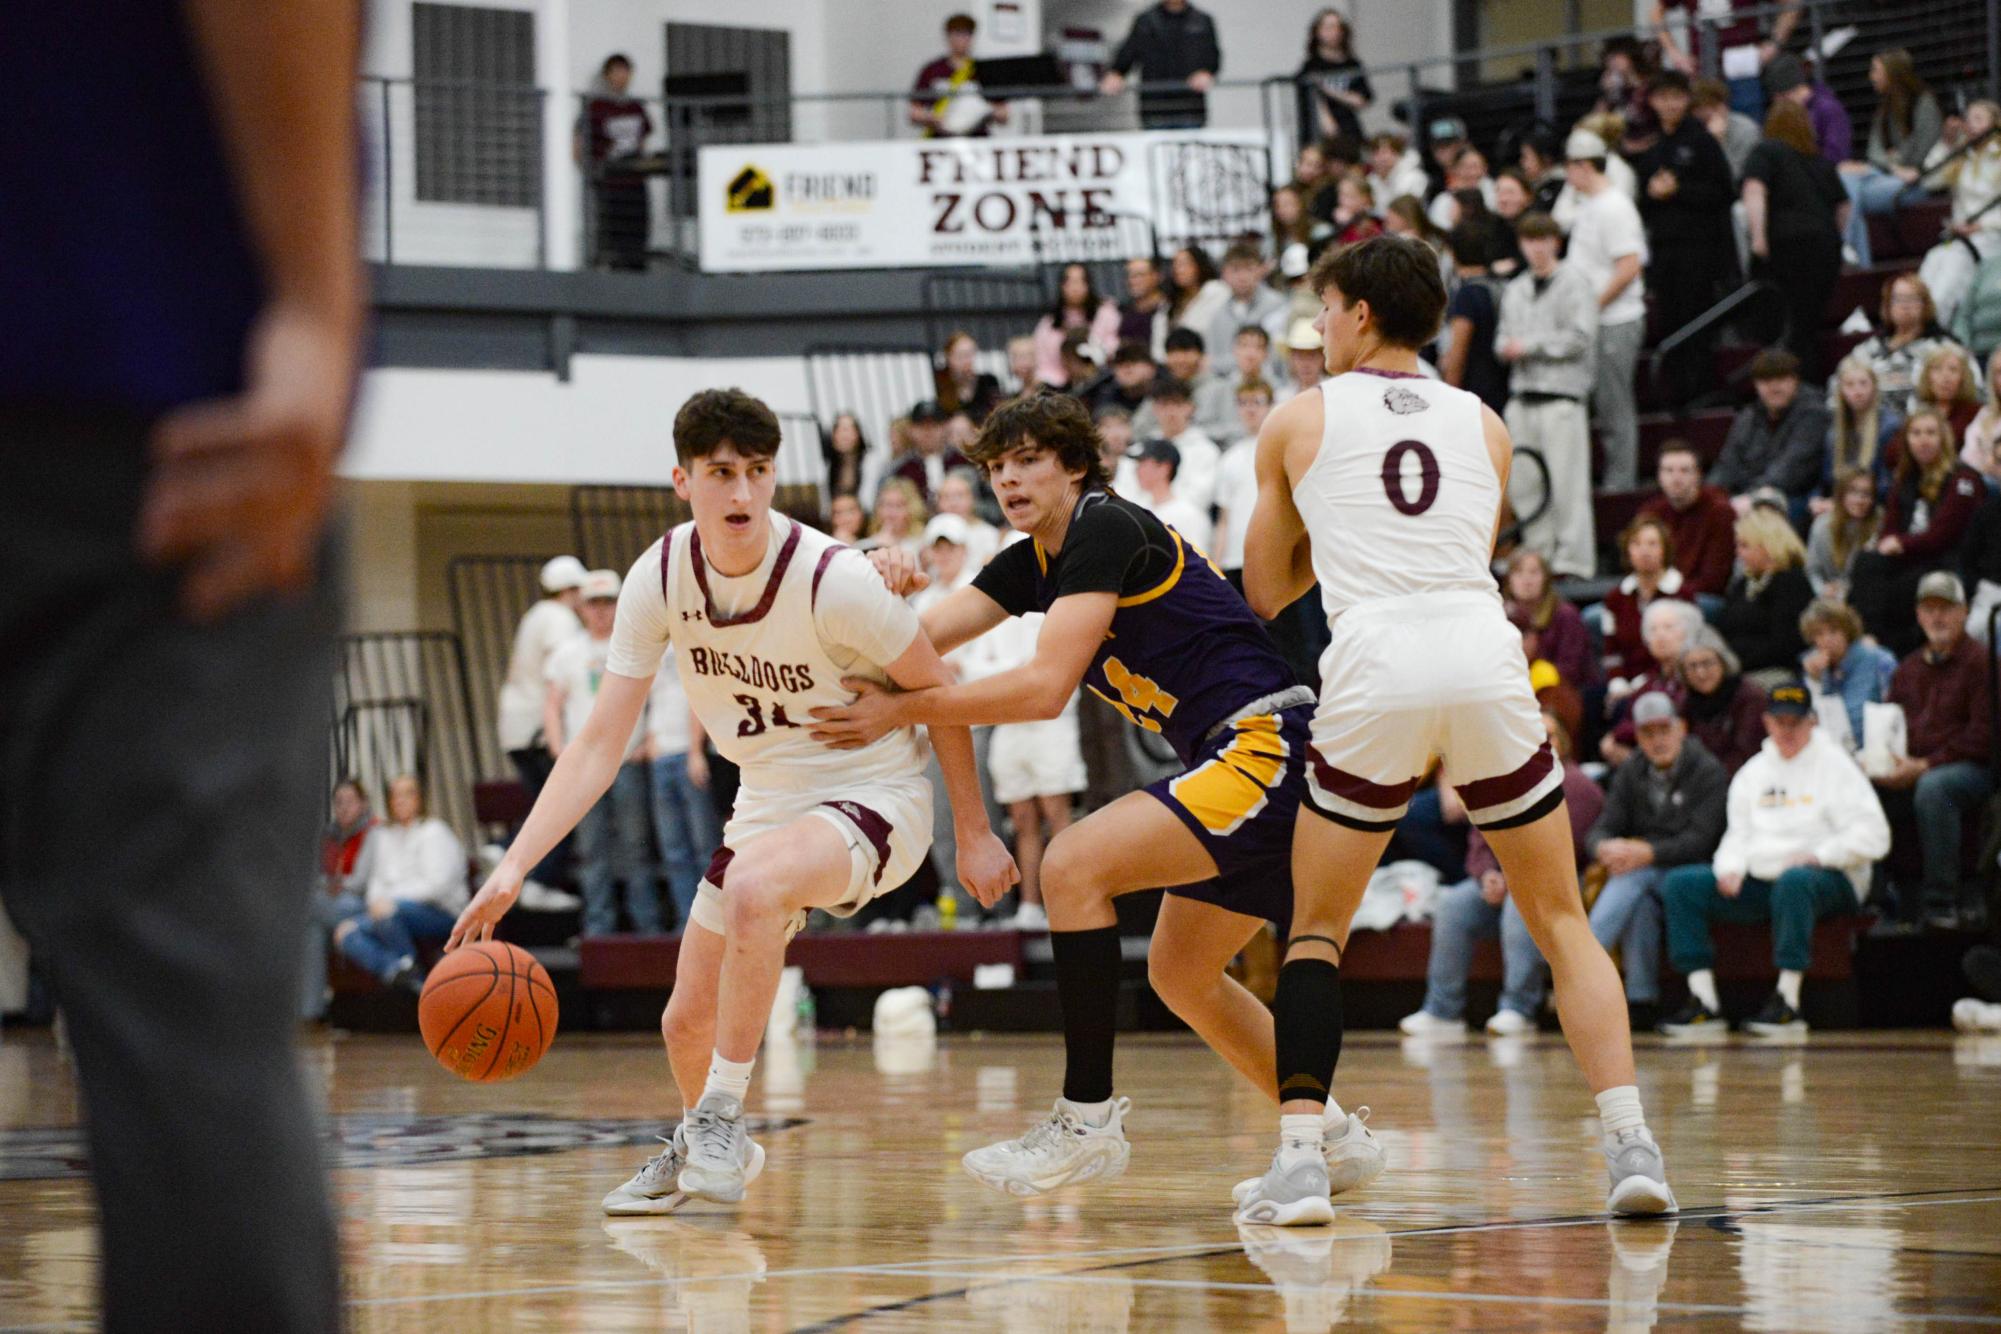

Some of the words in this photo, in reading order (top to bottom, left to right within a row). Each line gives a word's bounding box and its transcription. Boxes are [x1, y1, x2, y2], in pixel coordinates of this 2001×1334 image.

[918, 146, 1123, 184] FRIEND
[933, 189, 1116, 233] ZONE
[1380, 440, 1440, 516] 0
[690, 647, 815, 693] BULLDOGS
